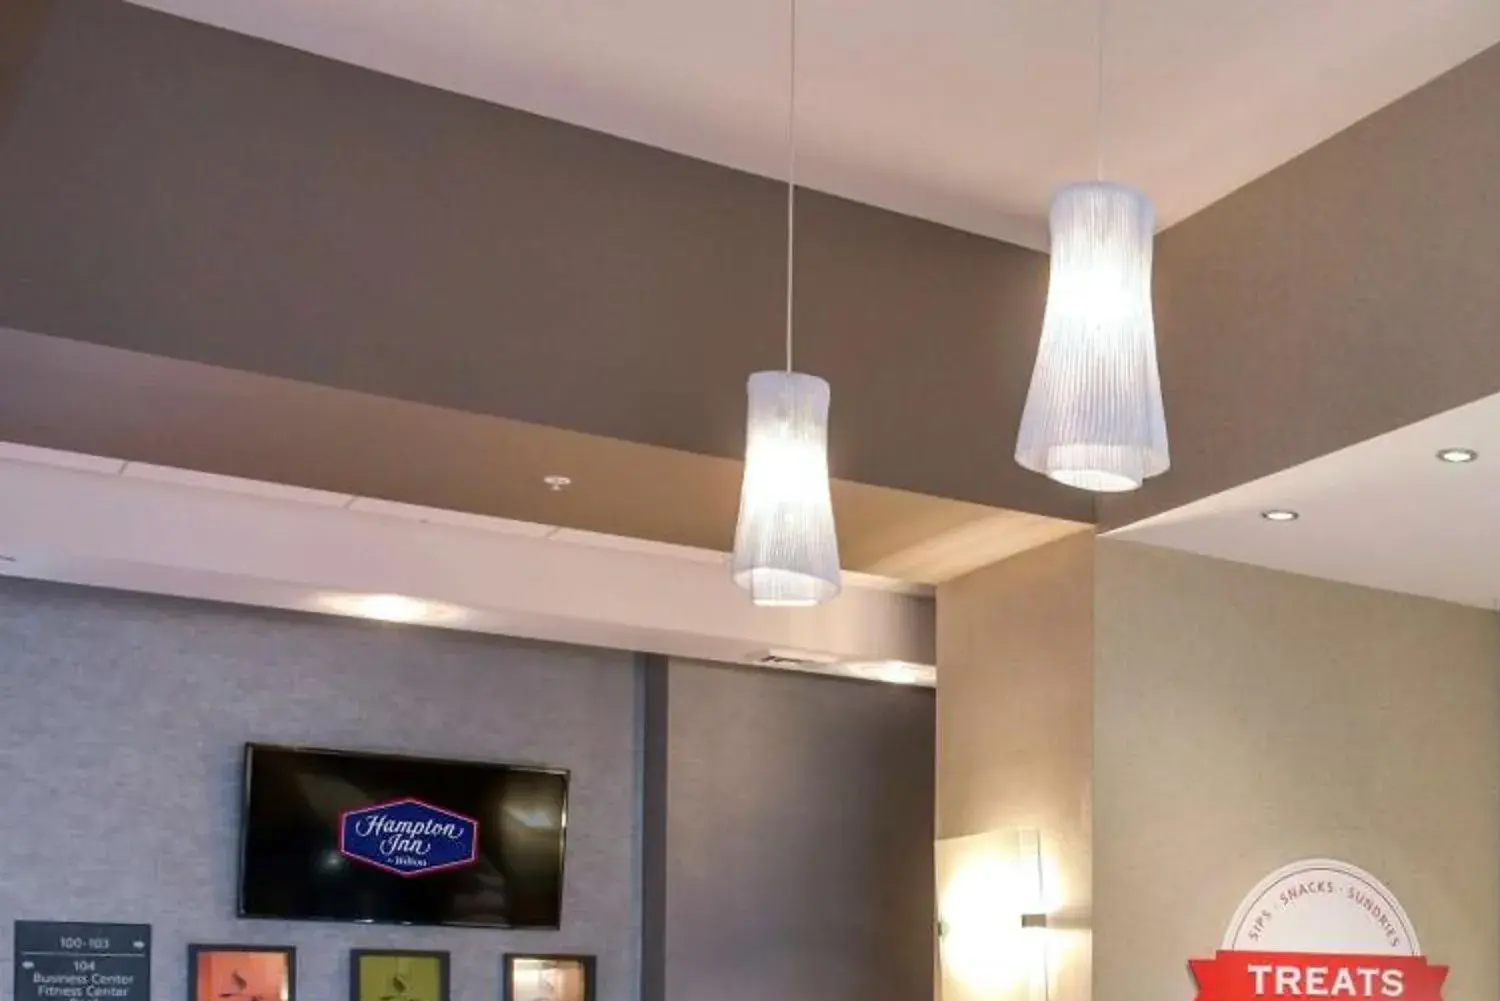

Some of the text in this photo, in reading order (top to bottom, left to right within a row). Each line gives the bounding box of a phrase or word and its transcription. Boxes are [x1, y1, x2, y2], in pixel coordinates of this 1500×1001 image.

[355, 814, 465, 839] Hampton
[380, 834, 431, 856] Inn
[1248, 881, 1400, 948] SIPS SNACKS SUNDRIES
[73, 960, 96, 972] 104
[33, 971, 134, 985] Business Center
[1248, 963, 1405, 998] TREATS
[37, 985, 130, 997] Fitness Center
